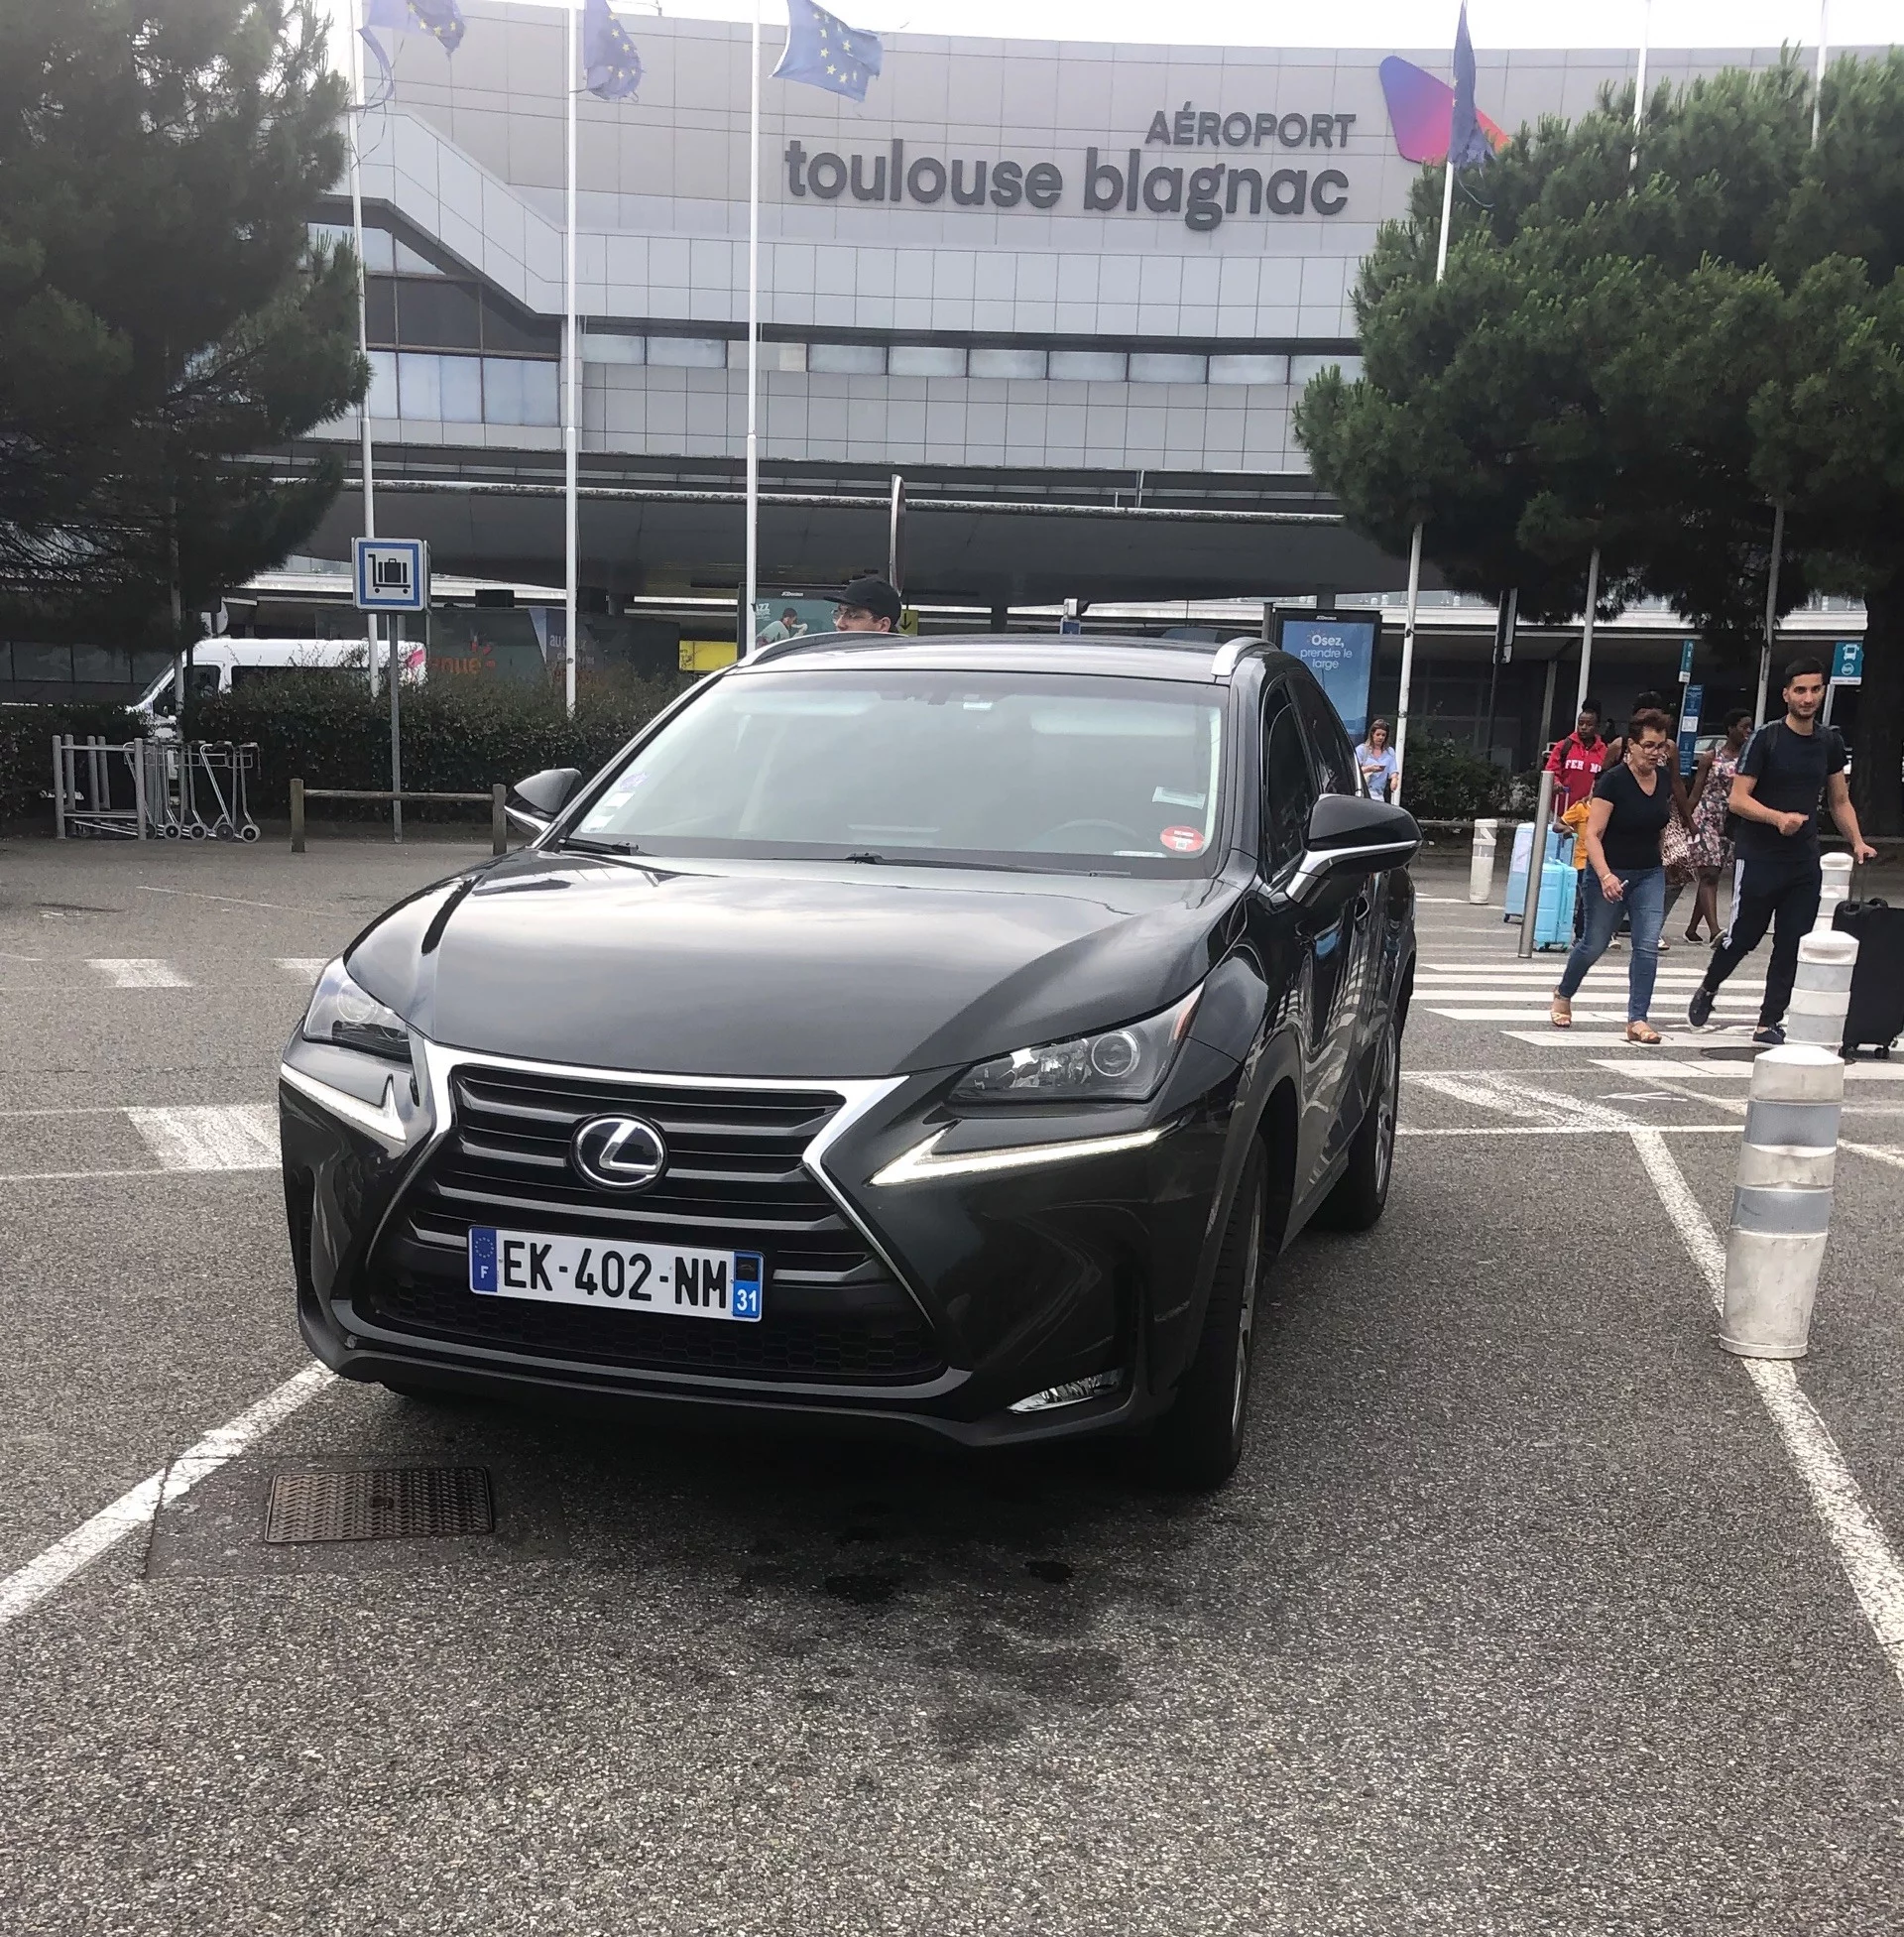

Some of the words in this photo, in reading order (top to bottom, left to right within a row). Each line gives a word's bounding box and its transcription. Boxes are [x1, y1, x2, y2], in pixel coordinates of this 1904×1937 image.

[1144, 100, 1357, 147] AÉROPORT
[784, 138, 1063, 209] toulouse
[1084, 146, 1350, 231] blagnac
[1312, 635, 1344, 648] Osez,
[1300, 649, 1341, 660] prendre
[1344, 649, 1352, 658] le
[1313, 659, 1339, 670] large
[480, 1266, 489, 1279] F
[503, 1239, 728, 1309] EK-402-NM
[736, 1288, 758, 1313] 31
